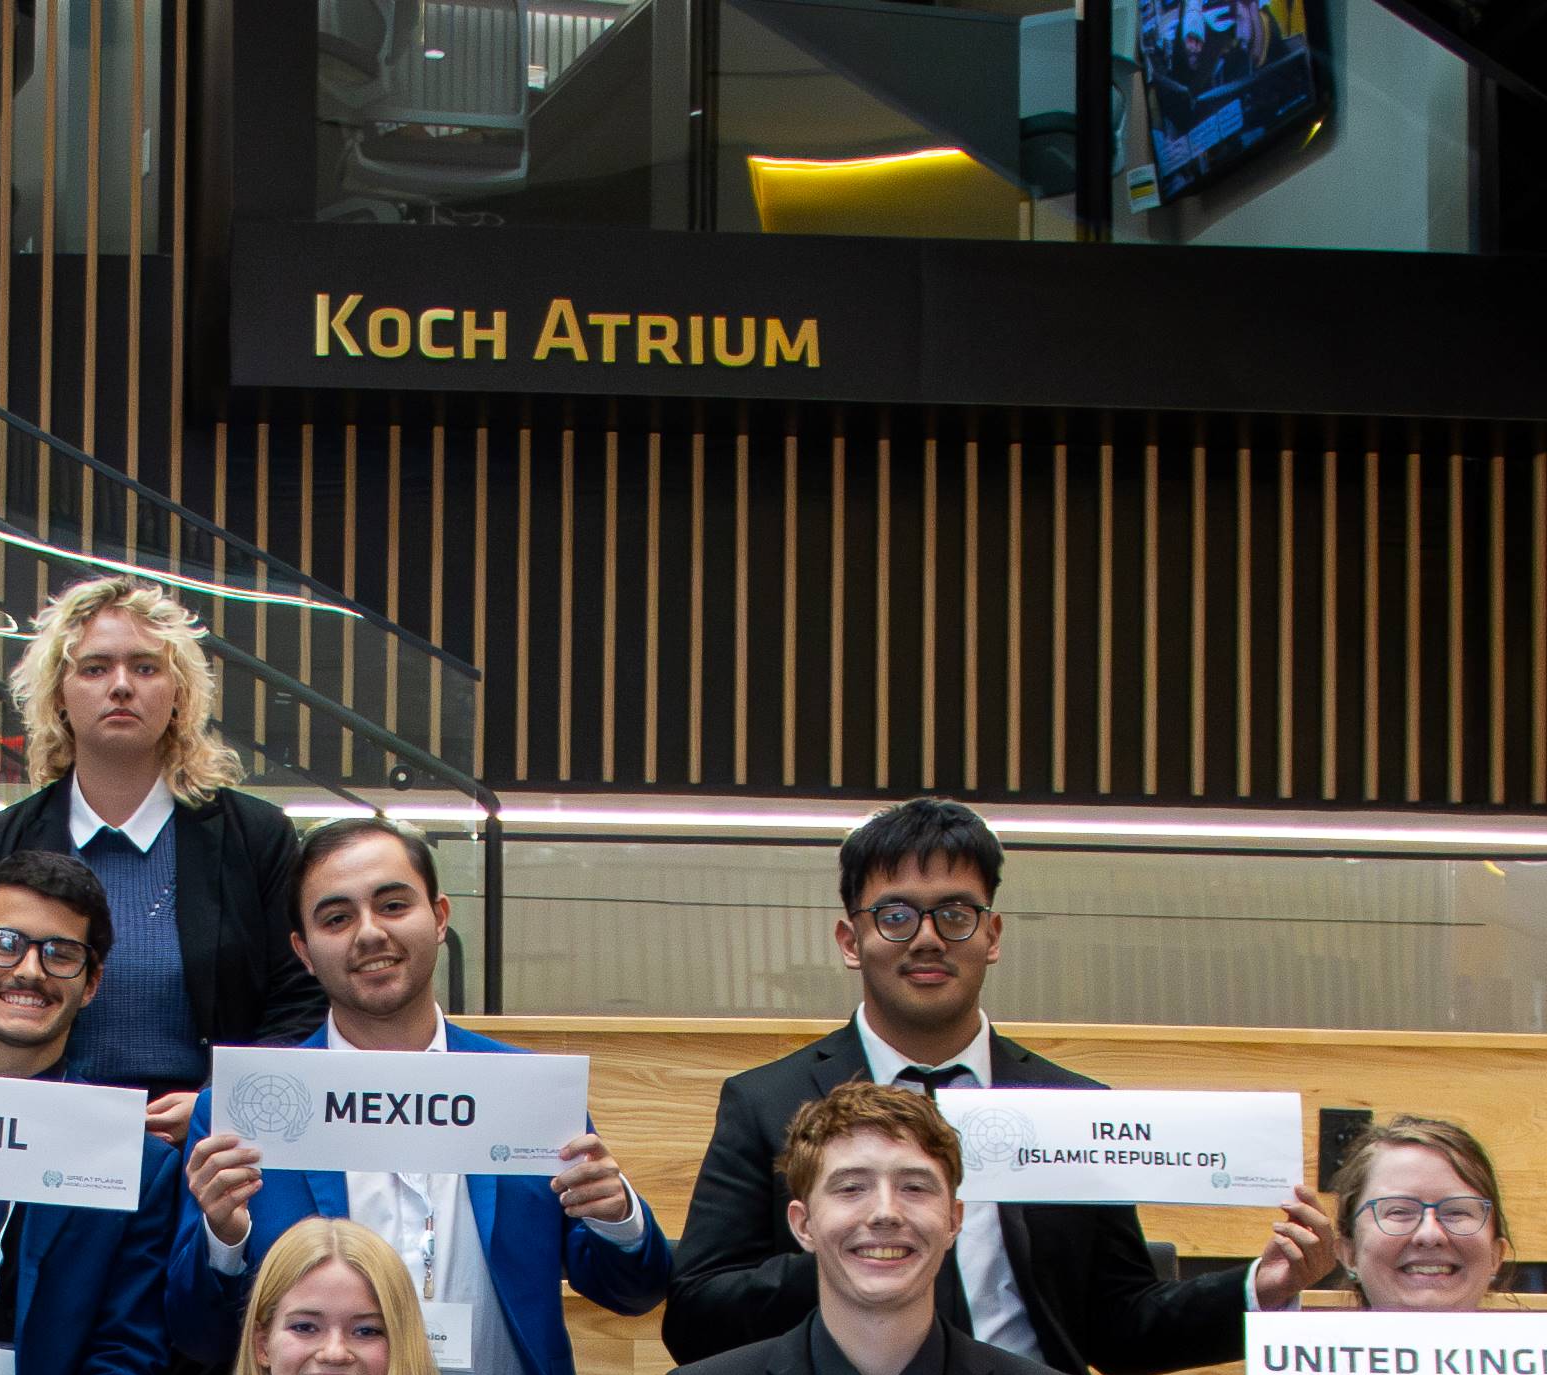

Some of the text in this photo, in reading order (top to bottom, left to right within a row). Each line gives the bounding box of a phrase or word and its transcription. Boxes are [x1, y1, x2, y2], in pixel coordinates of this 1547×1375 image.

[314, 292, 821, 368] KOCH ATRIUM
[324, 1091, 476, 1127] MEXICO
[1092, 1122, 1151, 1141] IRAN
[1016, 1147, 1227, 1171] (ISLAMIC REPUBLIC OF)
[1263, 1345, 1419, 1375] UNITED
